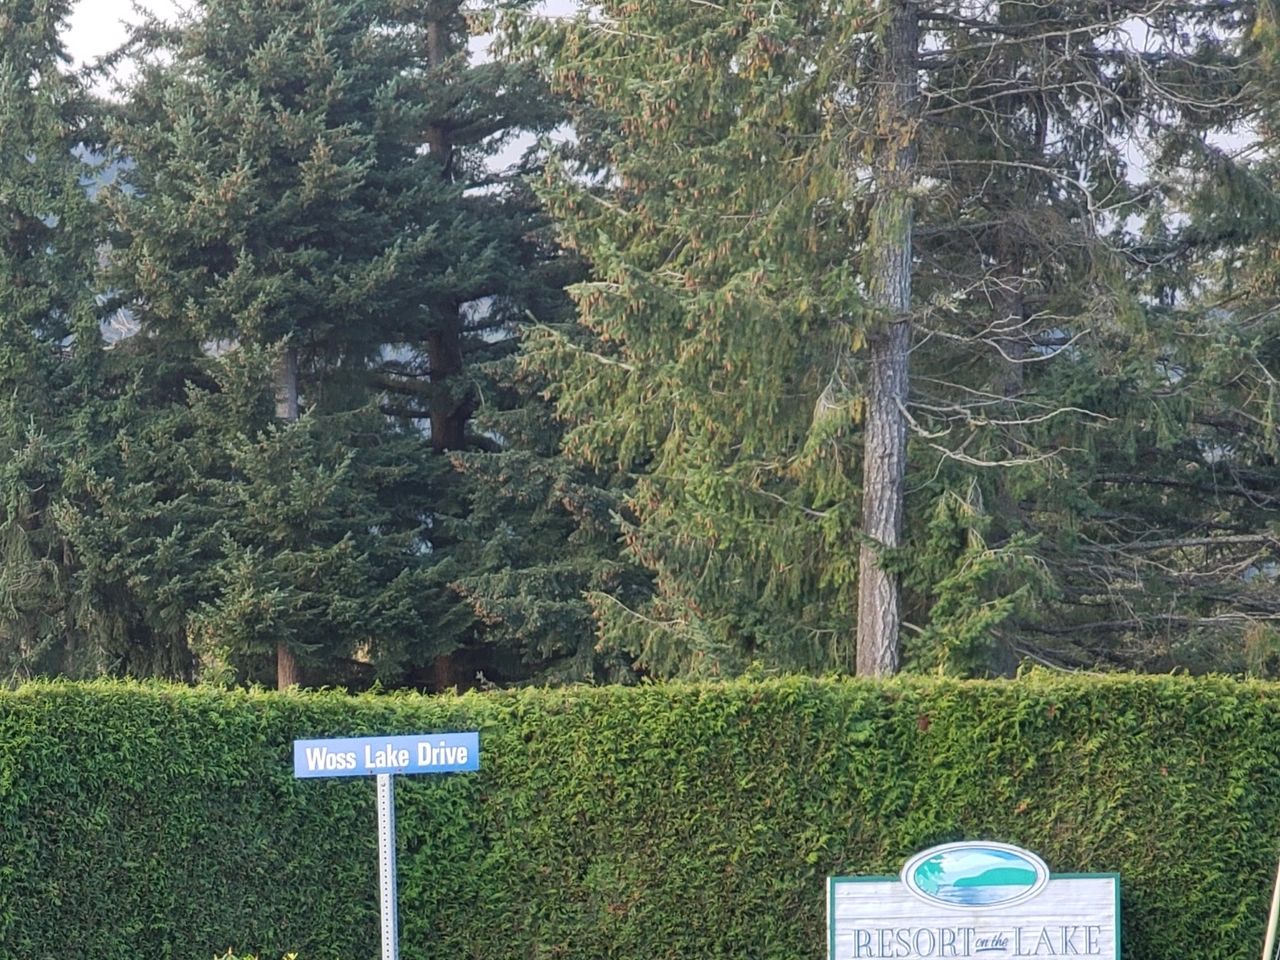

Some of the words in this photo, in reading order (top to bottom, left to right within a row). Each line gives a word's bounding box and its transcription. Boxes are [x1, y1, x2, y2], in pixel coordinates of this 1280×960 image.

[305, 747, 357, 771] Woss
[364, 744, 410, 769] Lake
[417, 740, 468, 766] Drive
[852, 927, 976, 959] RESORT
[975, 938, 989, 948] on
[991, 931, 1009, 947] the
[1012, 925, 1102, 957] LAKE
